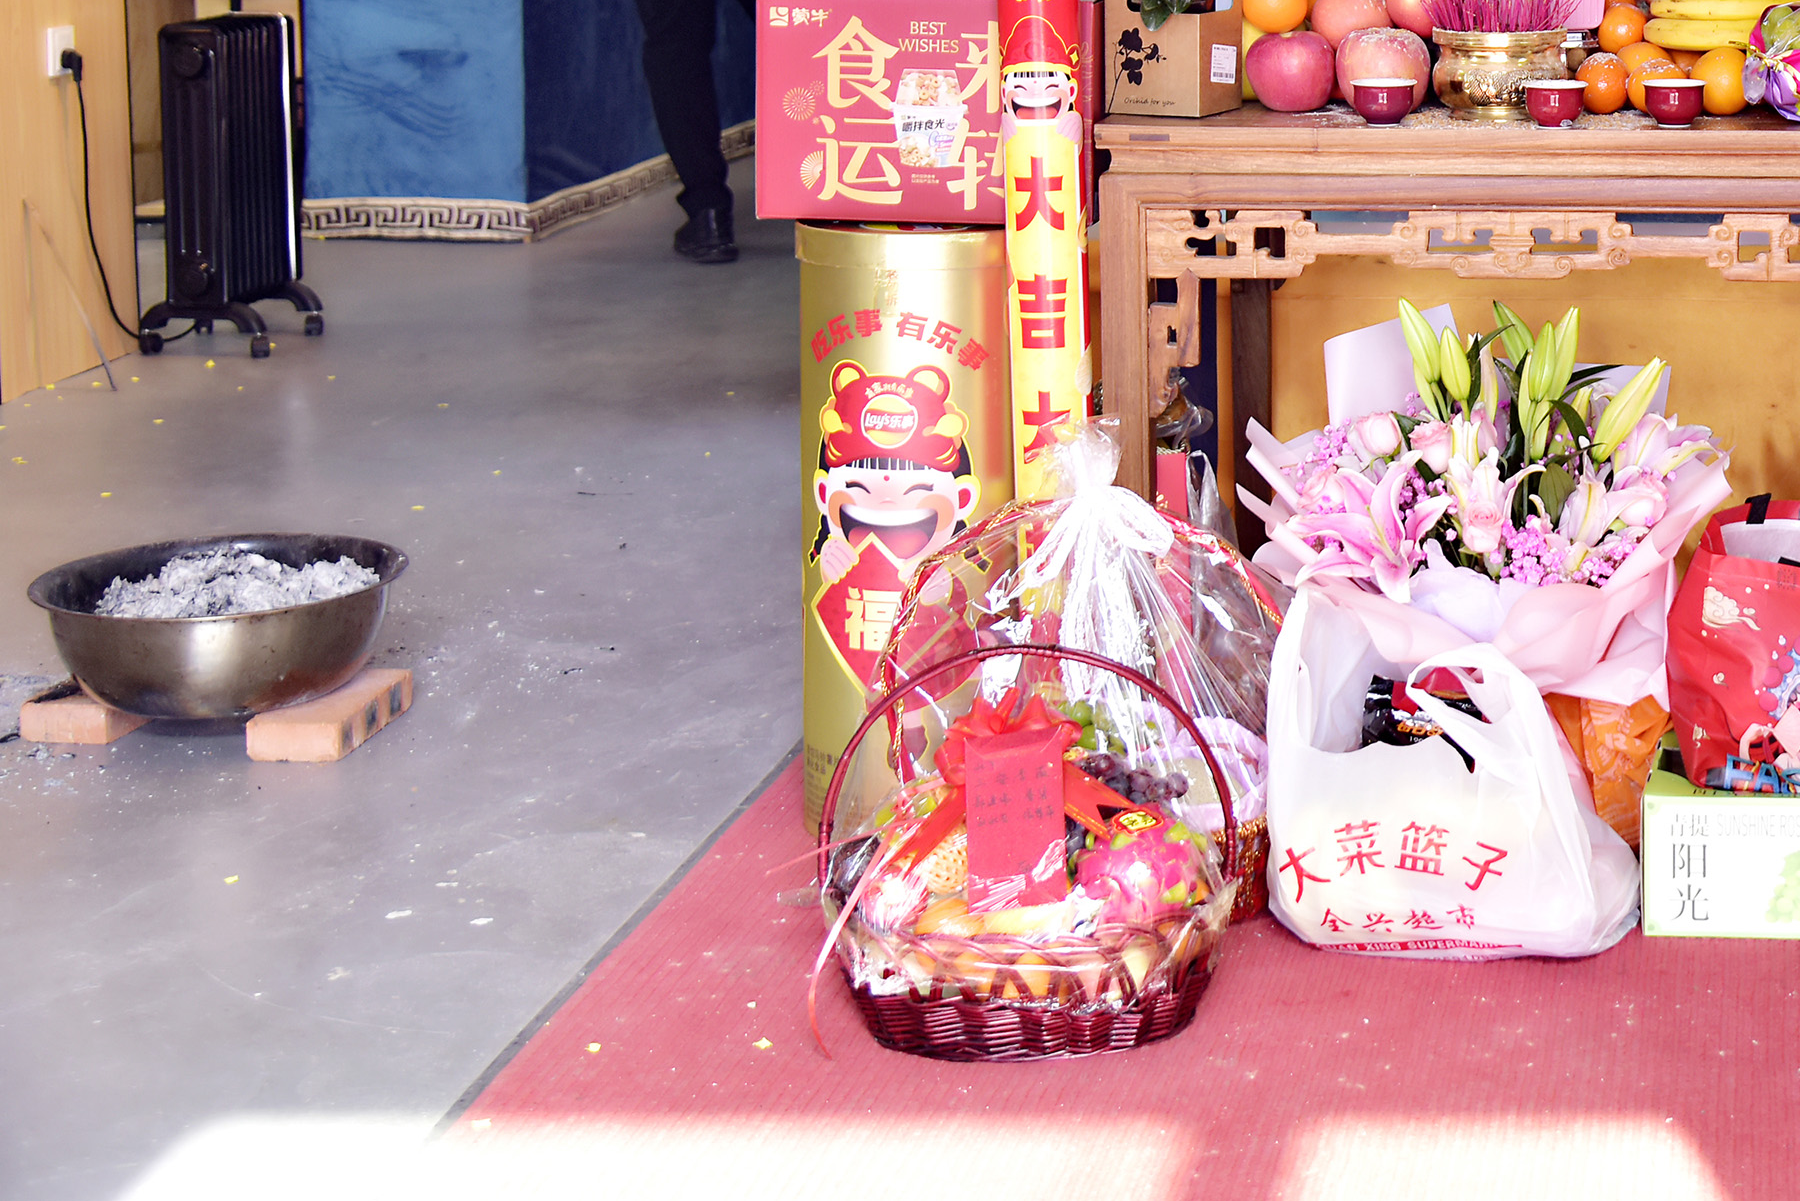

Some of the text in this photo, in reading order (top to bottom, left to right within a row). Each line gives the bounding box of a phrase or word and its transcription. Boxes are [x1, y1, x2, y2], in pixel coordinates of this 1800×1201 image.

[792, 7, 829, 27] 蒙牛
[910, 21, 947, 35] BEST
[898, 38, 960, 53] WISHES
[1124, 97, 1149, 105] Orchid
[1149, 98, 1160, 106] for
[810, 308, 990, 371] 吃乐事 有乐事
[845, 587, 903, 652] 福
[1717, 813, 1775, 838] SUNSHINE
[1279, 820, 1508, 903] 大菜篮子
[1671, 842, 1710, 922] 阳光
[1364, 942, 1401, 952] XING
